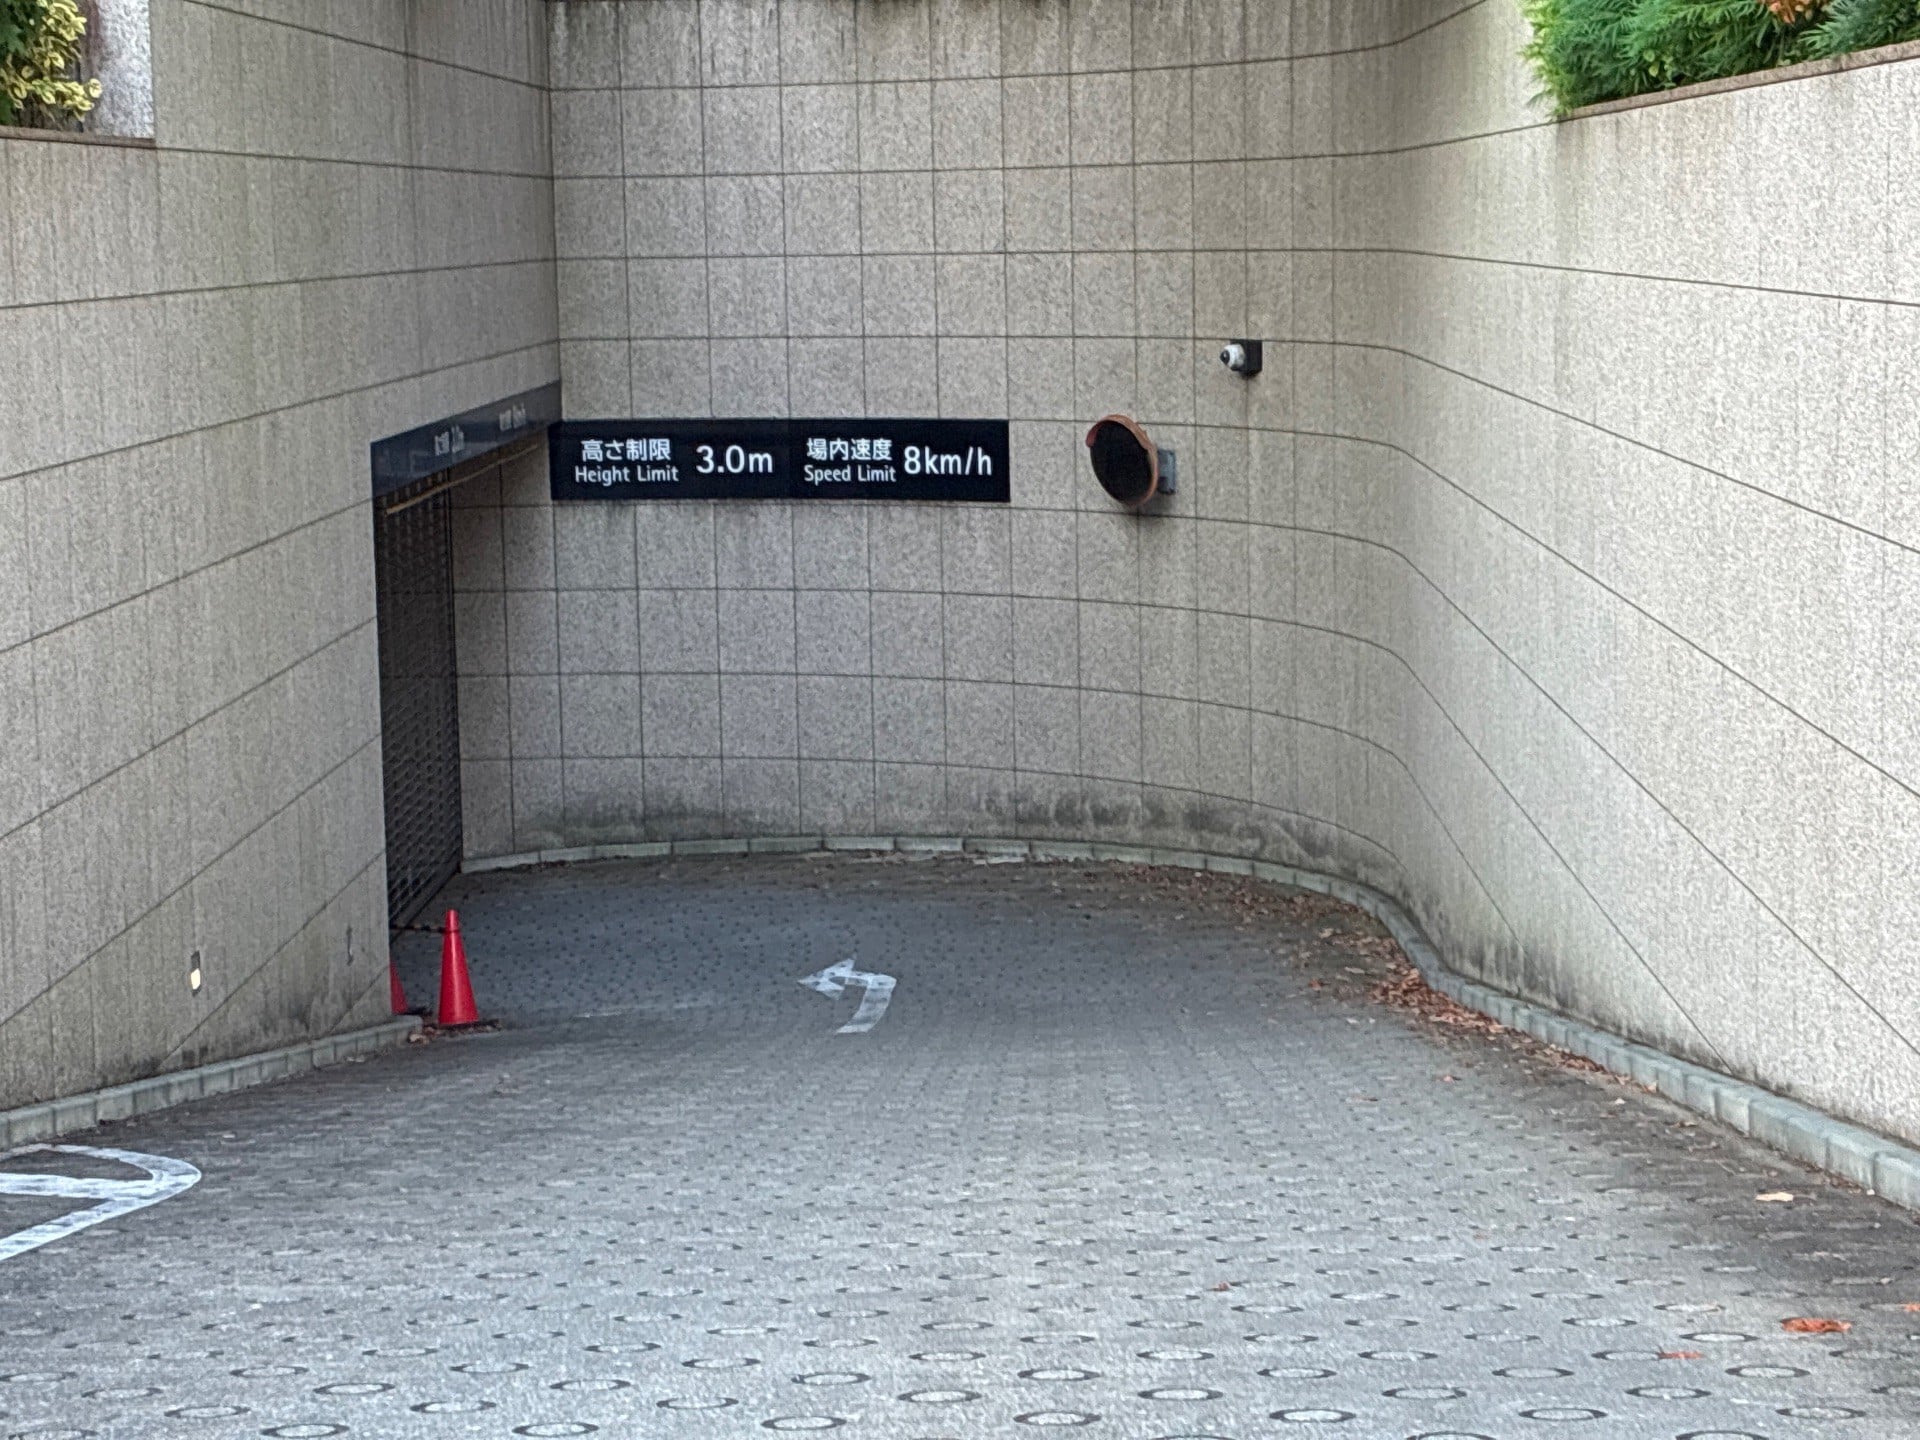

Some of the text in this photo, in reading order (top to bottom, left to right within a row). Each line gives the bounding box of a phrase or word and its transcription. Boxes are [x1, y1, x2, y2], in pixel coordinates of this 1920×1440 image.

[581, 438, 672, 462] 高さ制限
[696, 445, 774, 474] 3.0m
[806, 437, 893, 462] 場内速度
[904, 446, 992, 476] 8km/h
[575, 464, 679, 487] Height Limit
[804, 464, 896, 486] Speed Limit
